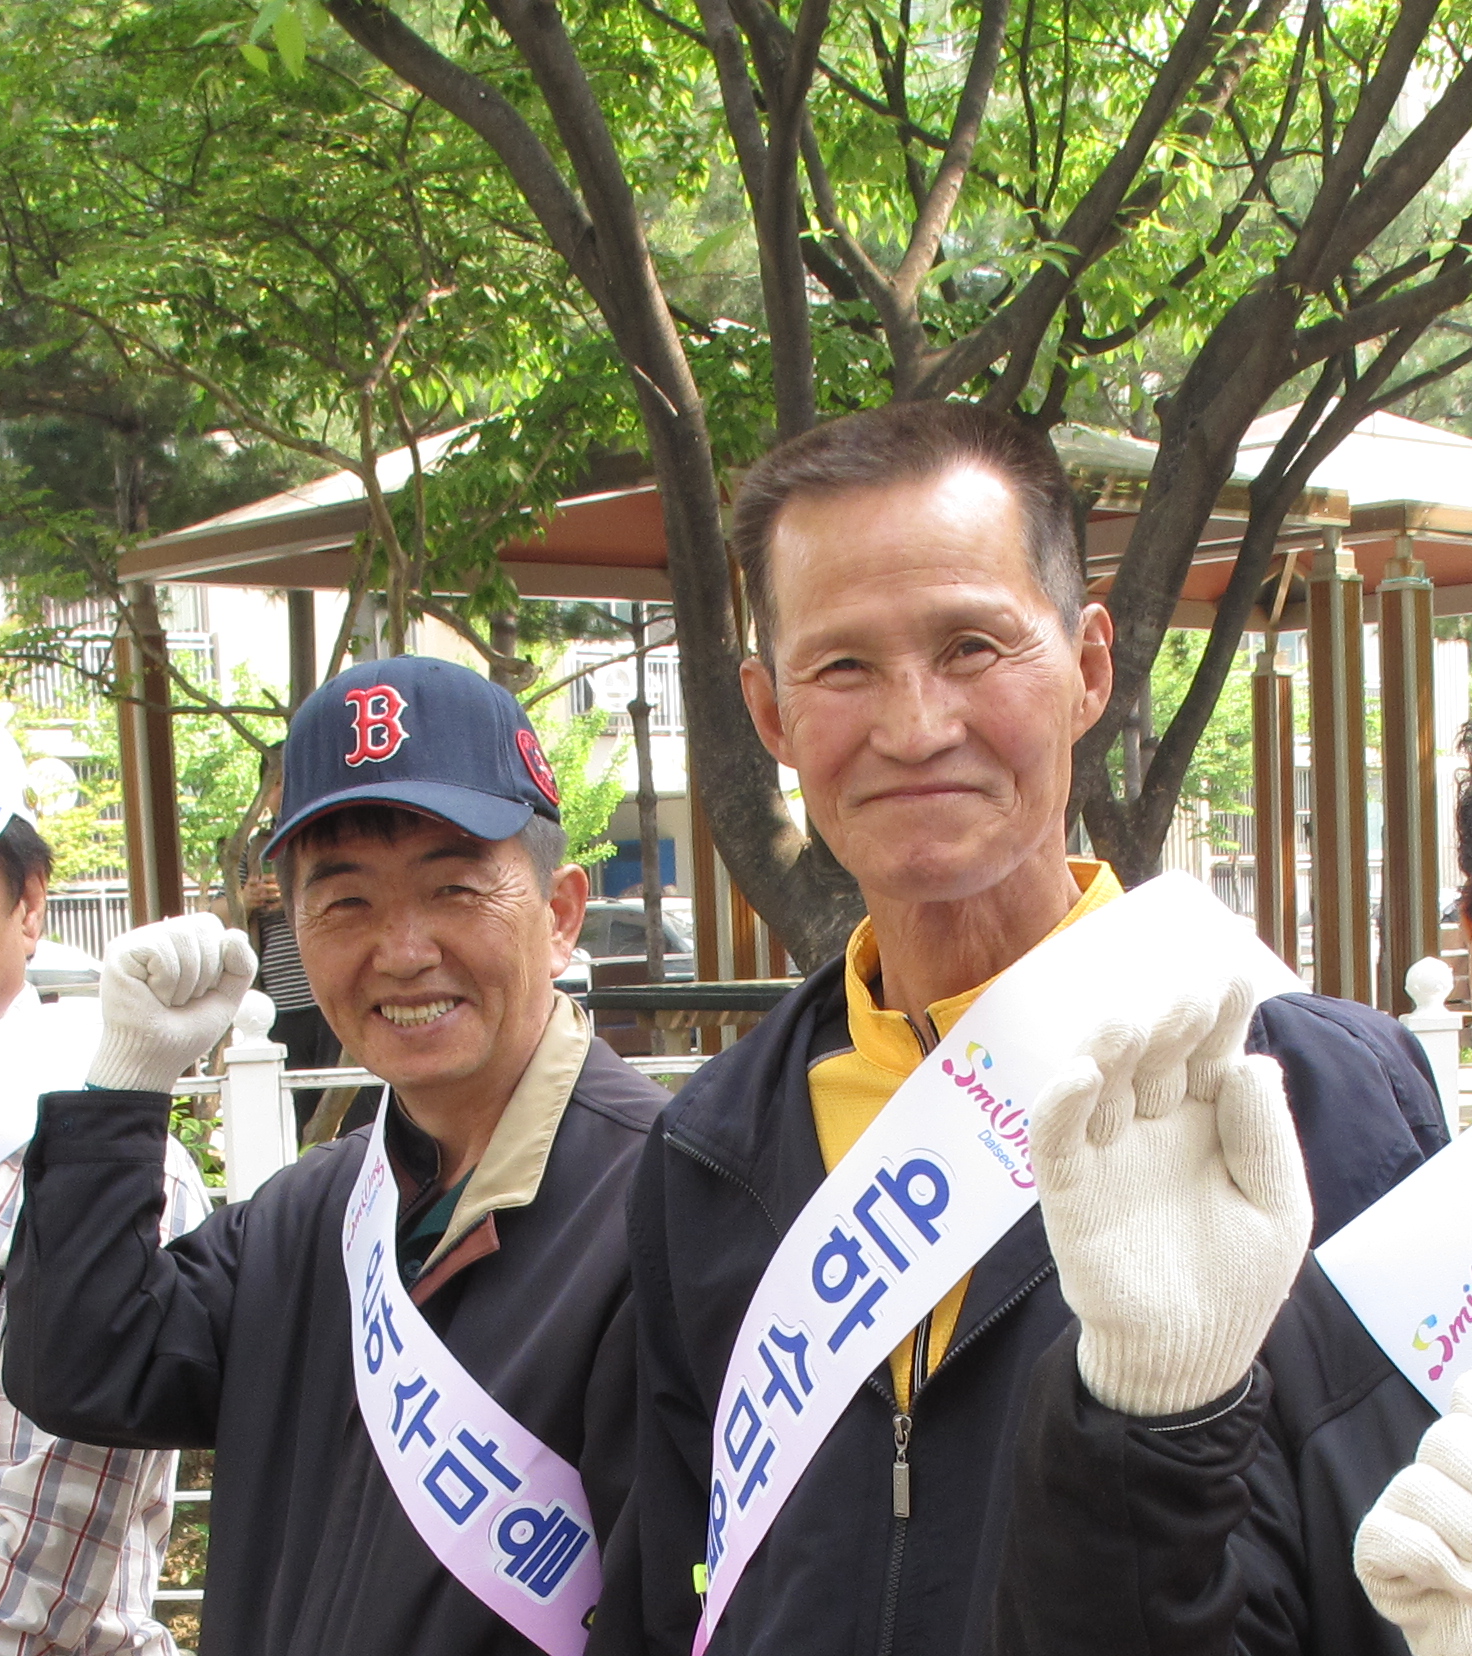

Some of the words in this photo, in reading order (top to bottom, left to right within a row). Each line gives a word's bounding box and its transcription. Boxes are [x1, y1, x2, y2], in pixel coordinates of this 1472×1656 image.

[343, 683, 411, 768] B
[977, 1129, 1015, 1170] Dalseo
[361, 1239, 591, 1599] 은하수마을
